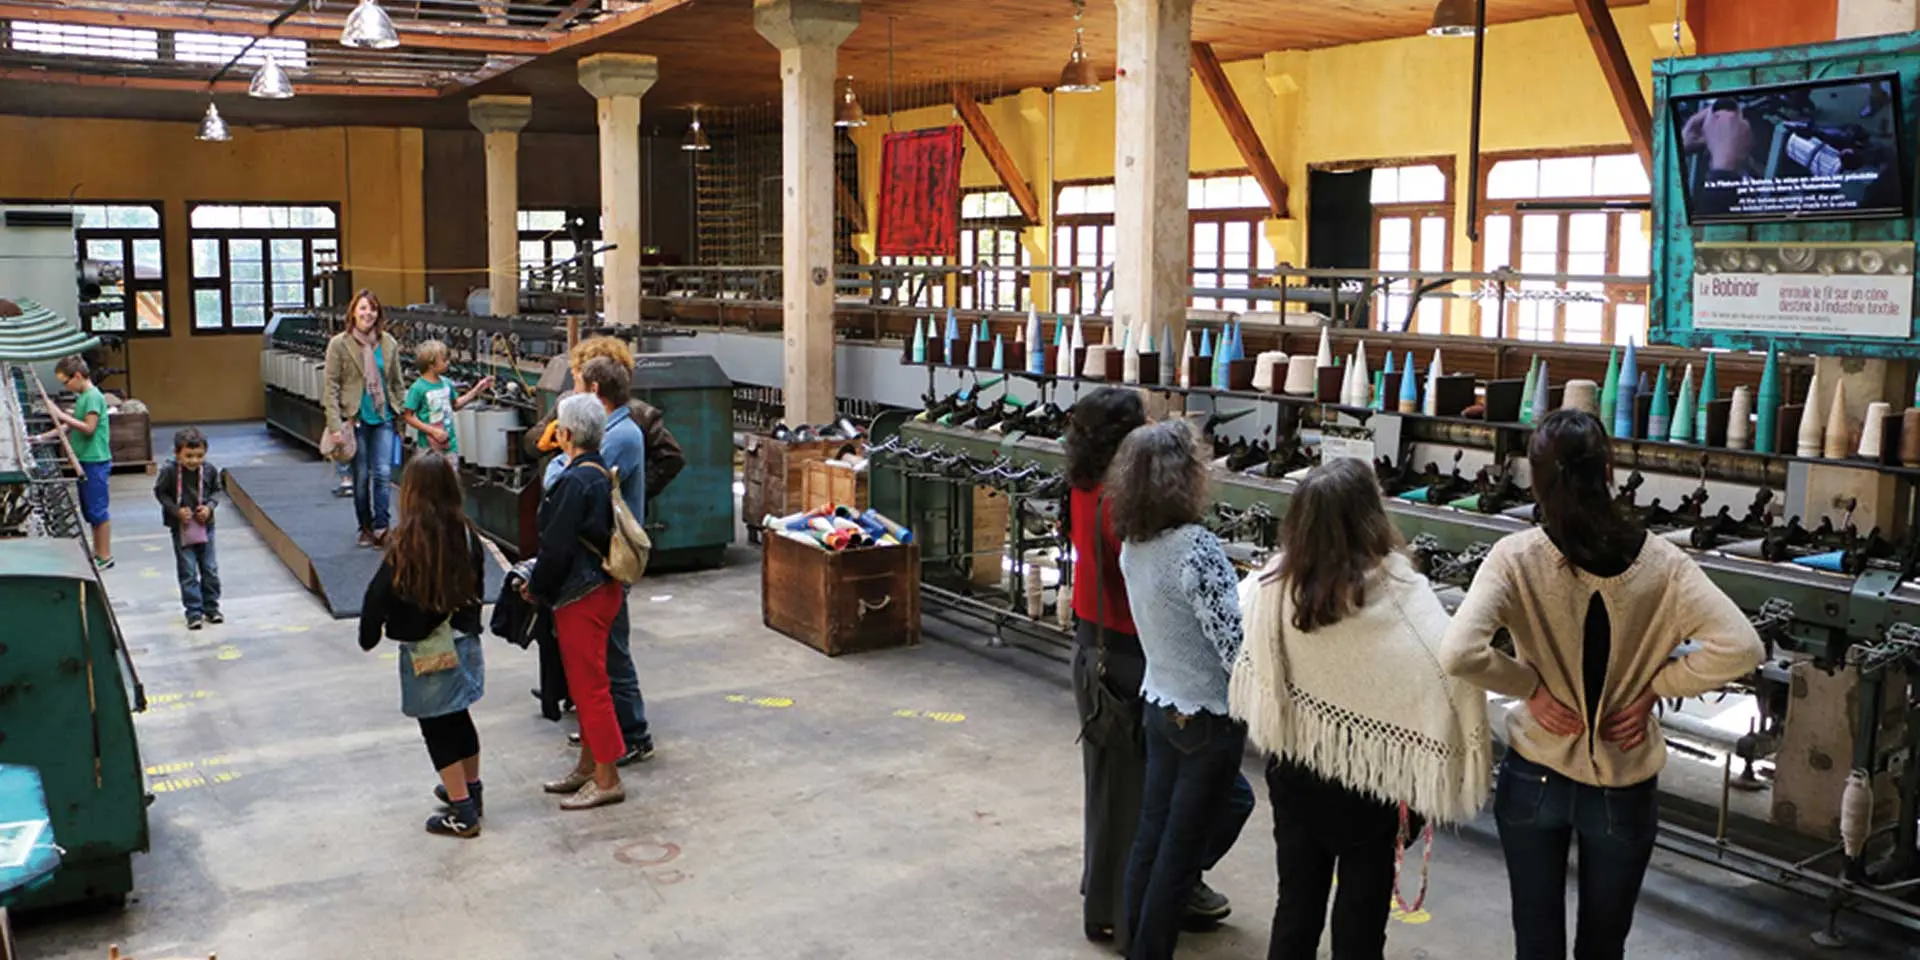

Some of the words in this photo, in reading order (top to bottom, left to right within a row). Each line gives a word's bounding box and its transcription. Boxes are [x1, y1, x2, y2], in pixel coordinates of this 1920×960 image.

[1700, 281, 1709, 296] Le
[1712, 277, 1760, 297] Bobinoir
[1812, 285, 1821, 299] le
[1835, 287, 1849, 300] sur
[1851, 288, 1863, 301] un
